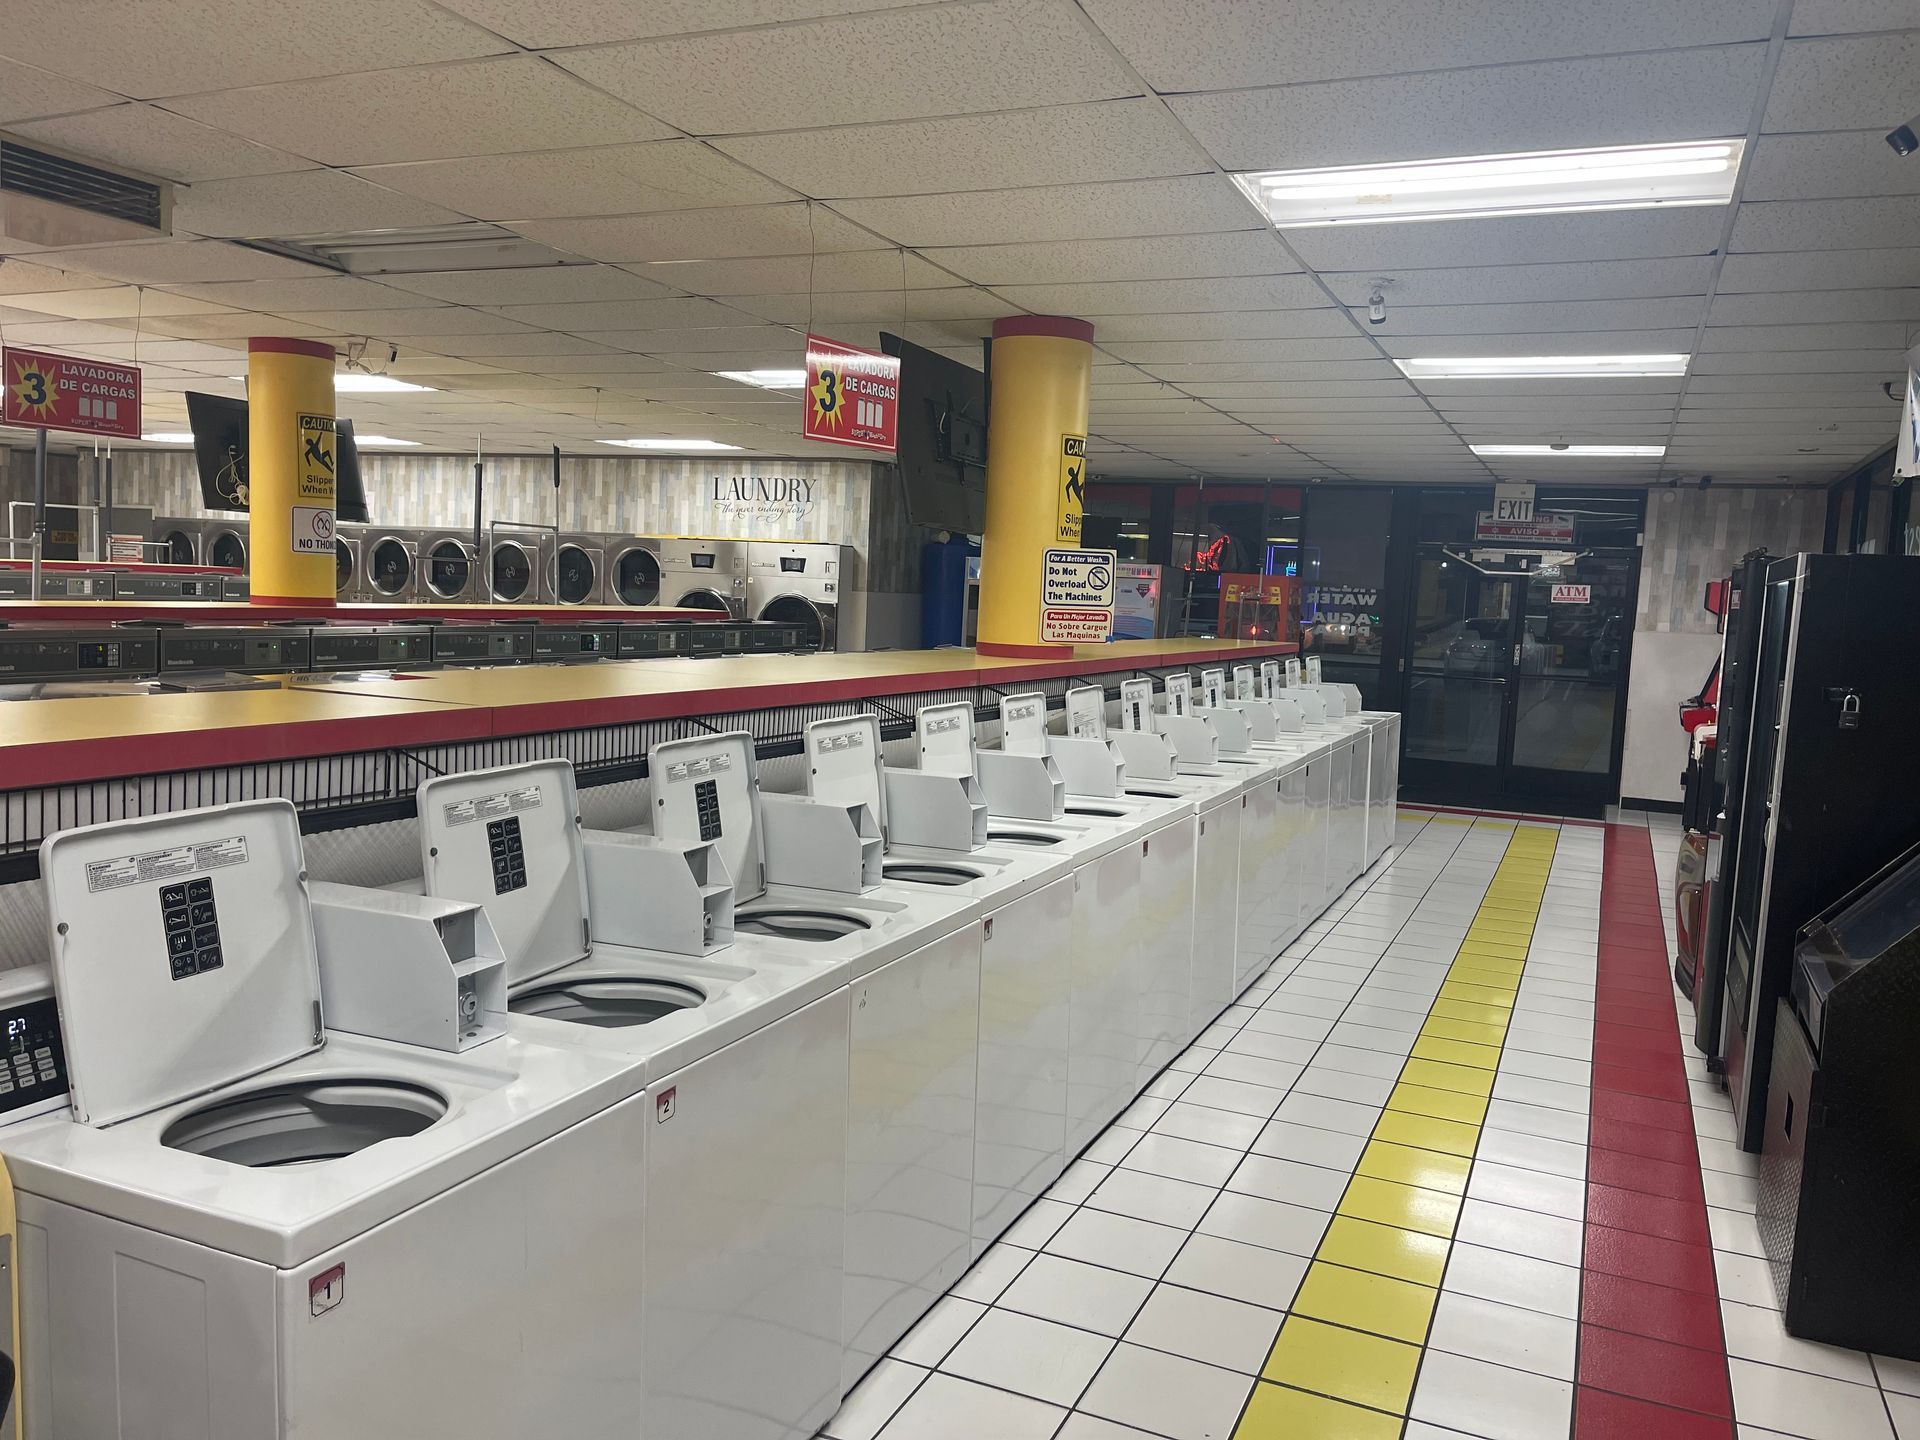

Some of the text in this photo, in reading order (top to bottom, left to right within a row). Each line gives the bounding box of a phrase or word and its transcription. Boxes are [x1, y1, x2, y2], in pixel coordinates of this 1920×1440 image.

[62, 364, 134, 384] LAVADORA
[23, 372, 46, 404] 3
[60, 379, 136, 399] DE CARGAS
[820, 370, 836, 412] 3
[846, 376, 896, 400] DE CARGAS
[302, 485, 328, 494] When
[713, 477, 817, 502] LAUNDRY
[756, 500, 784, 523] ending
[1498, 500, 1532, 520] EXIT
[1510, 527, 1539, 535] AVISO
[300, 538, 312, 549] NO
[1049, 566, 1078, 576] Do Not
[1048, 580, 1086, 588] Overload
[1556, 586, 1586, 596] ATM
[1048, 592, 1102, 602] The Machines
[1082, 624, 1108, 632] Cargue
[664, 1100, 670, 1114] 2
[324, 1282, 330, 1300] 1
